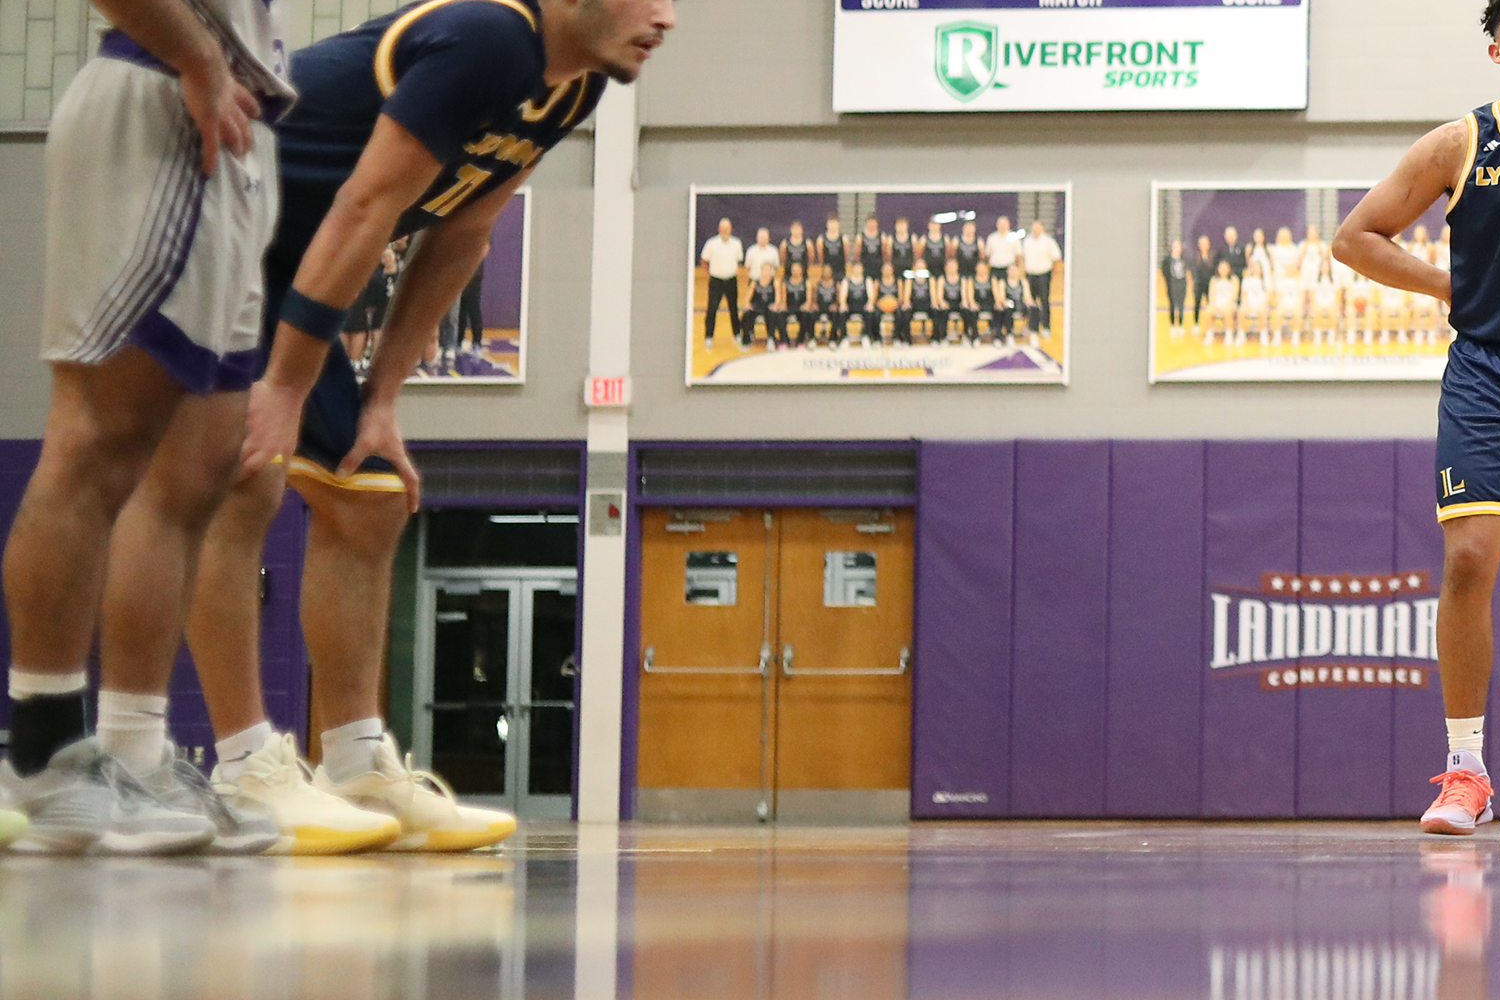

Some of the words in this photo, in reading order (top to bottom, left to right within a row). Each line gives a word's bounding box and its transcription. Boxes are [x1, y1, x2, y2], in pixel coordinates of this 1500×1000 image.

[1103, 69, 1200, 88] SPORTS
[592, 376, 625, 405] EXIT
[1211, 593, 1439, 668] LANDMAR
[1267, 667, 1422, 687] CONFERENCE
